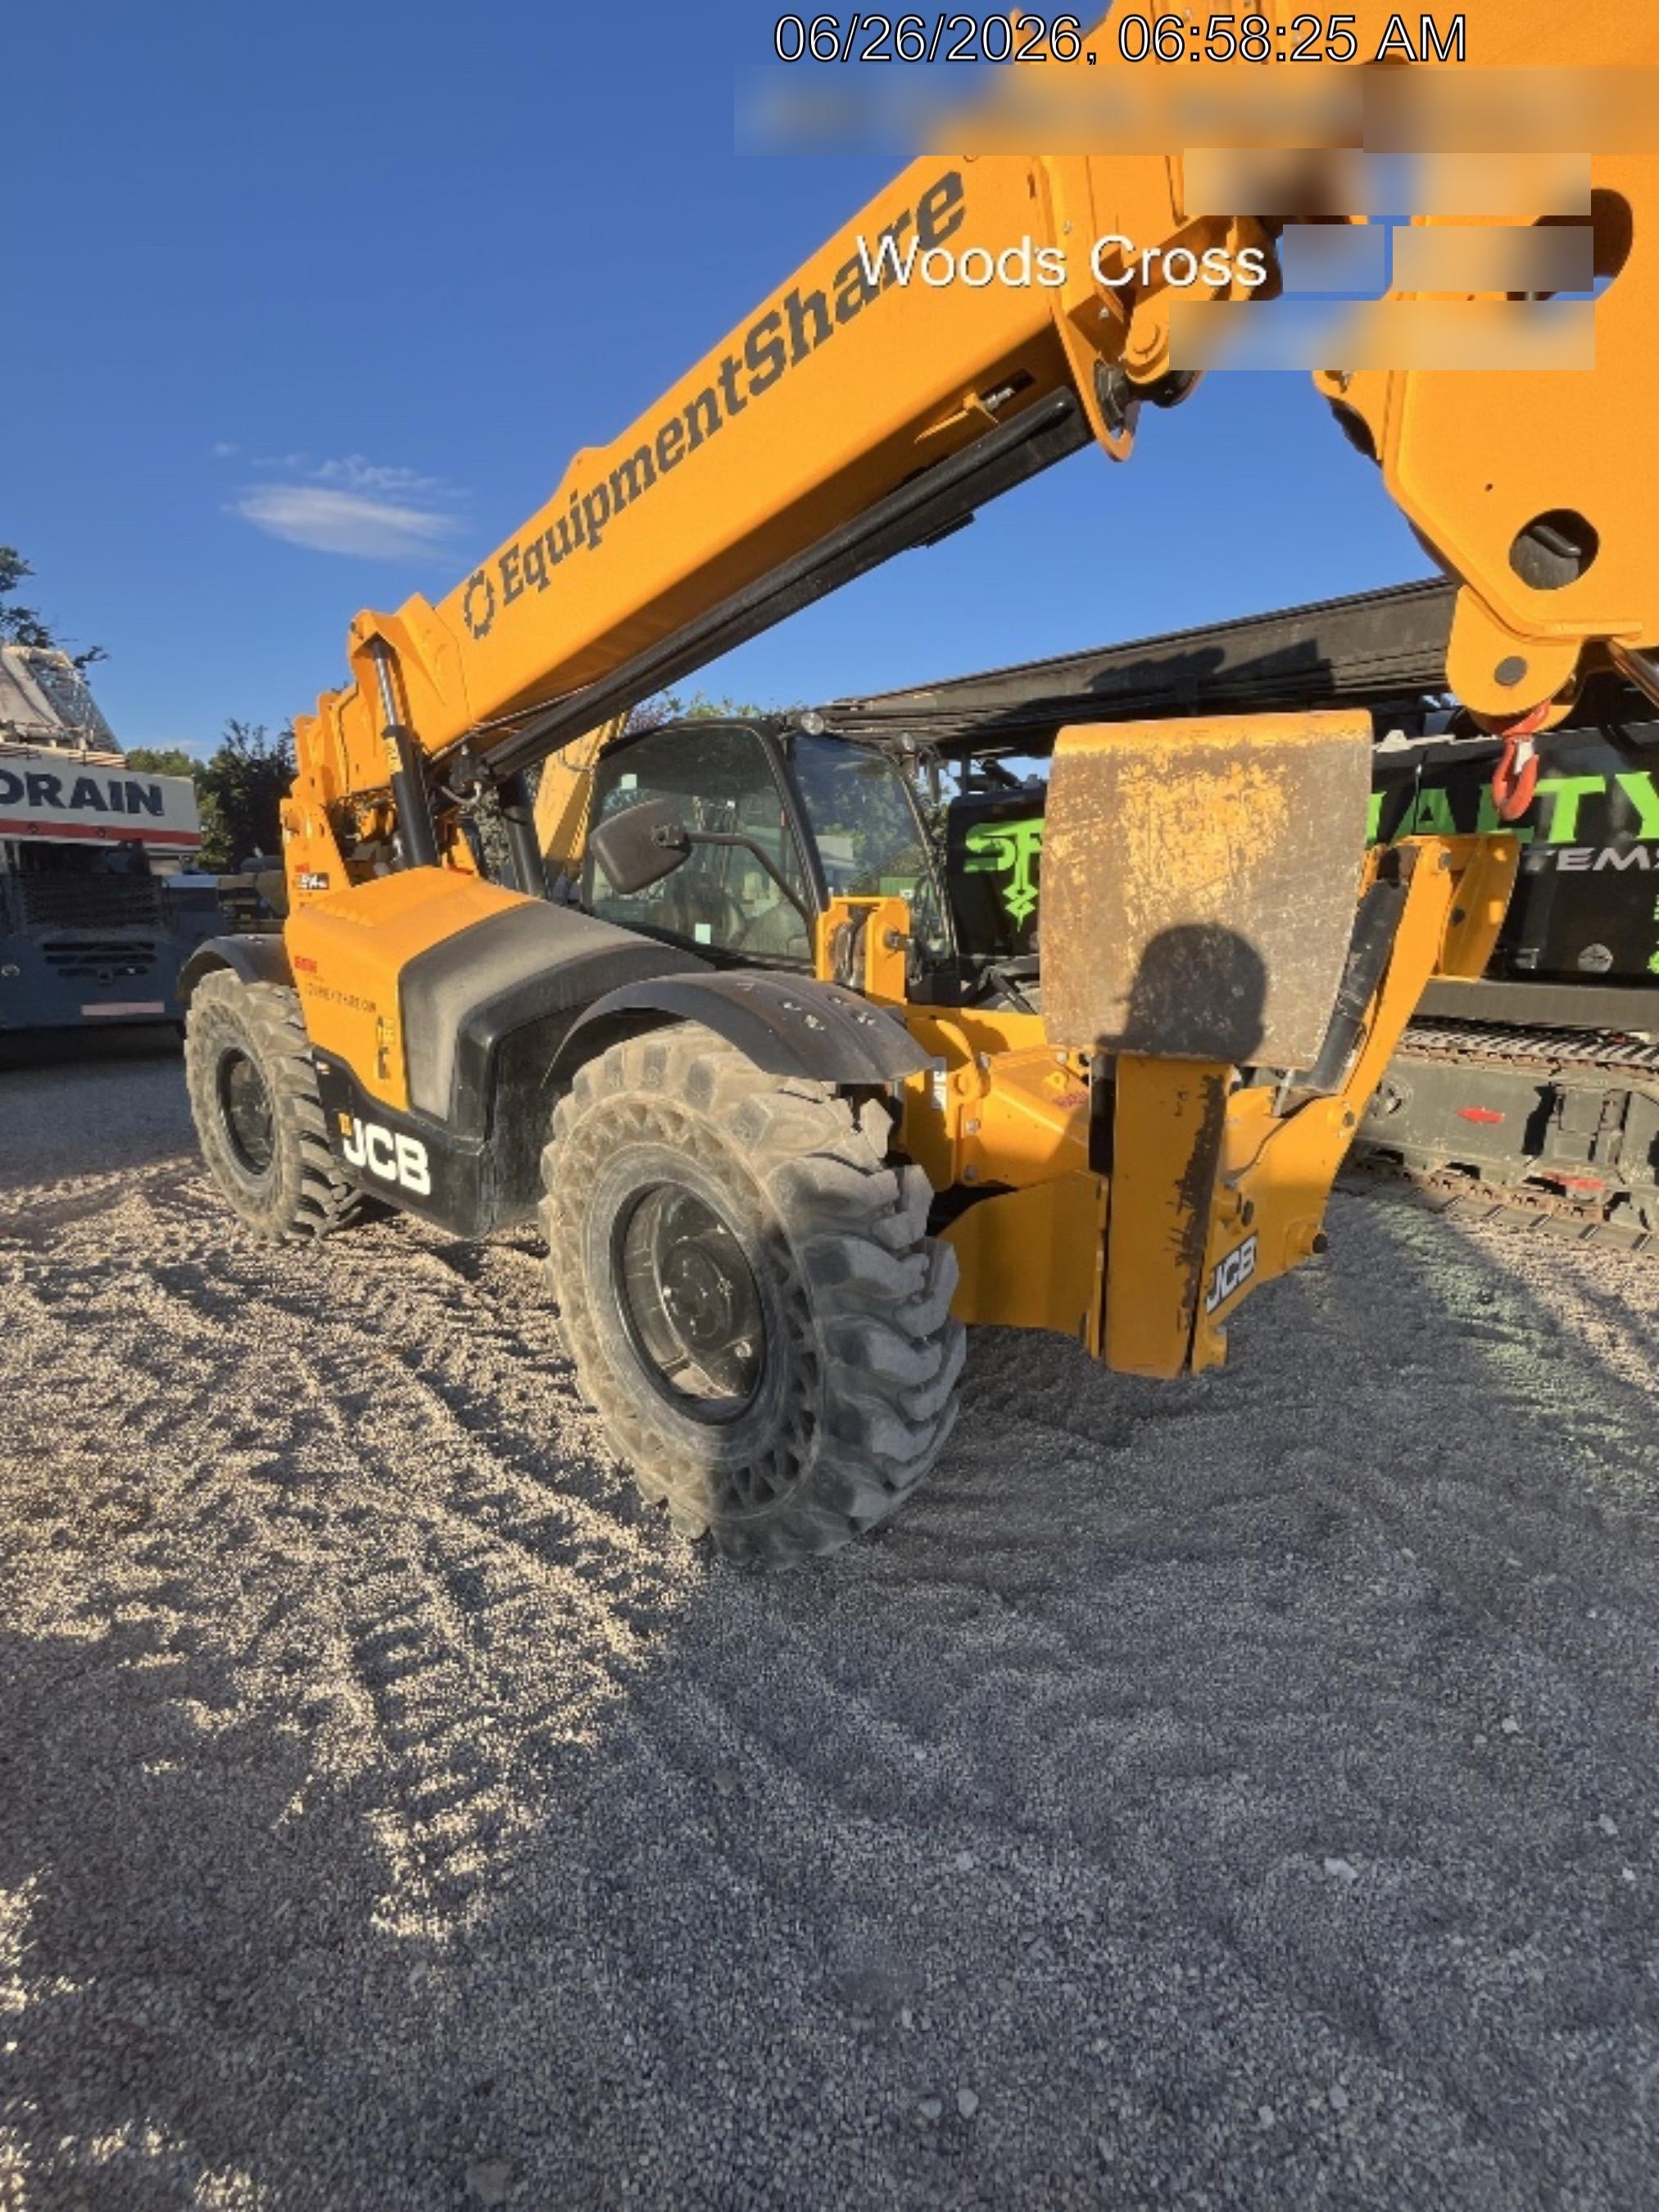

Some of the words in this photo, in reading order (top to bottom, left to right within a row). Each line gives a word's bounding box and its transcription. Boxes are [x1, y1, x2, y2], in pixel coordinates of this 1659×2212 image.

[497, 170, 967, 609] EquipmentShare
[342, 1117, 432, 1197] JCB
[1206, 1235, 1257, 1313] JCB
